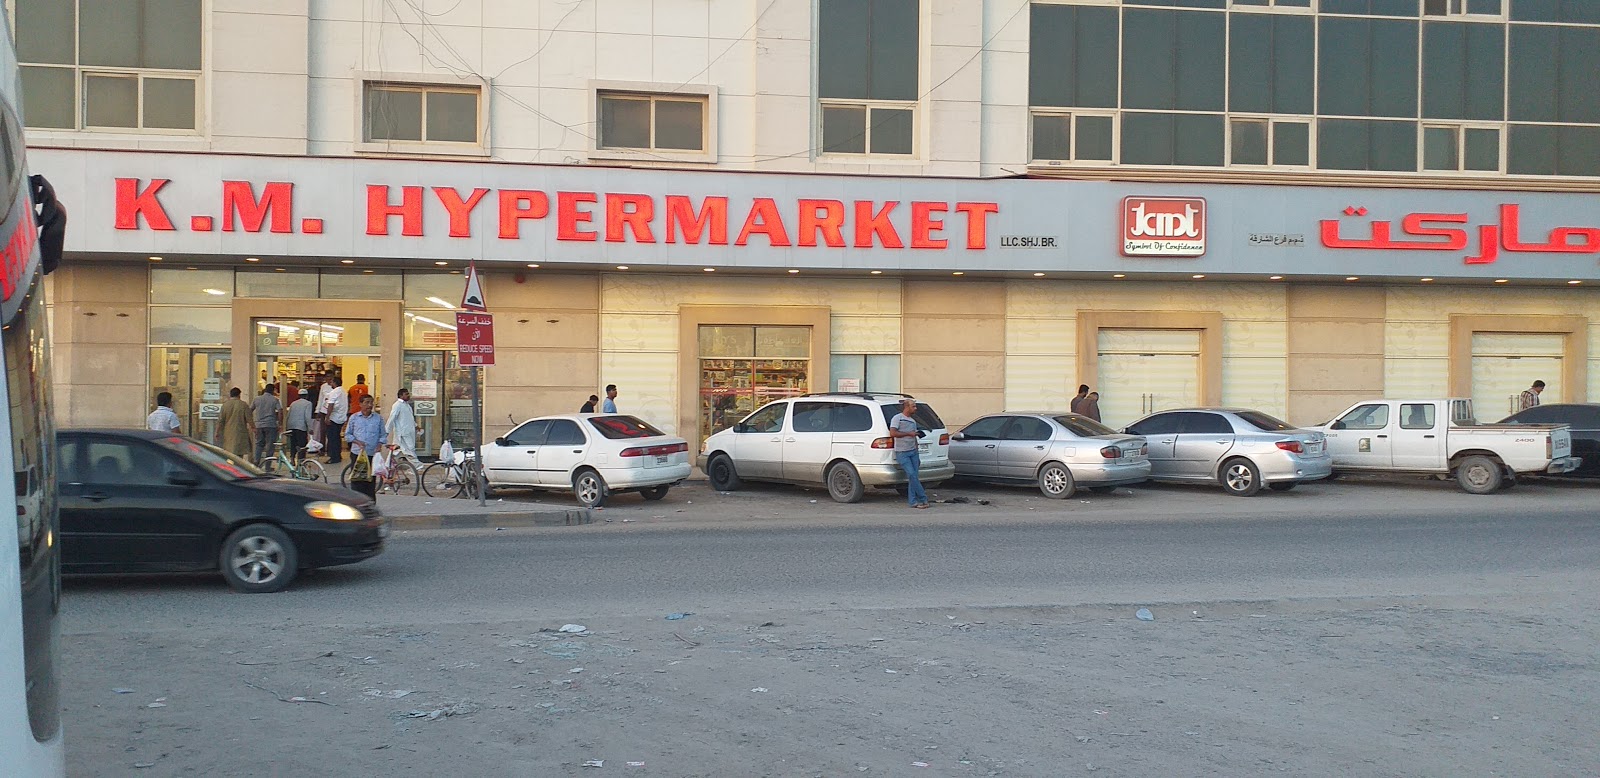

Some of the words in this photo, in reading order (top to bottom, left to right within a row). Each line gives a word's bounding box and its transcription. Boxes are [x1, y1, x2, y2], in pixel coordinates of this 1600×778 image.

[113, 177, 324, 234] K.M.
[365, 183, 999, 250] HYPERMARKET
[1125, 241, 1152, 251] Symbol
[1165, 242, 1203, 251] Confidence
[458, 315, 478, 326] السرعة
[477, 317, 492, 326] خفف
[459, 344, 478, 353] REDUCE
[479, 345, 493, 353] SPEED
[471, 355, 483, 363] NOW
